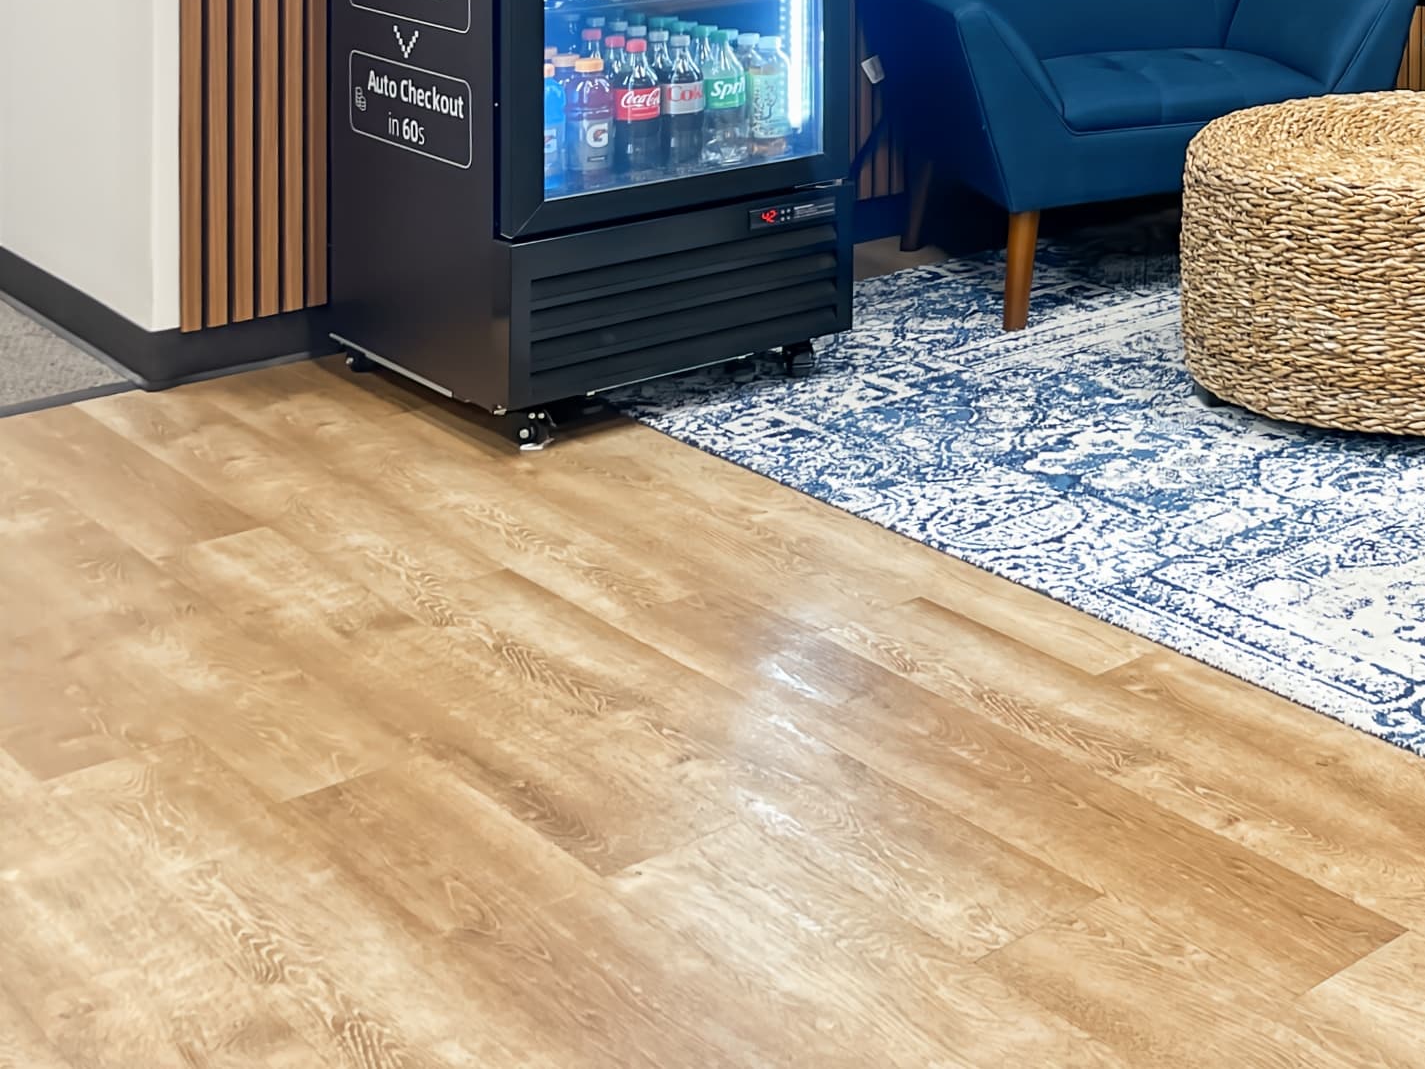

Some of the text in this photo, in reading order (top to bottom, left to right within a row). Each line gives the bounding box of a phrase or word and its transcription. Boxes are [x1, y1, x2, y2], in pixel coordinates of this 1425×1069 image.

[367, 70, 464, 119] Auto Checkout
[388, 111, 425, 146] in 60s
[587, 122, 609, 148] G
